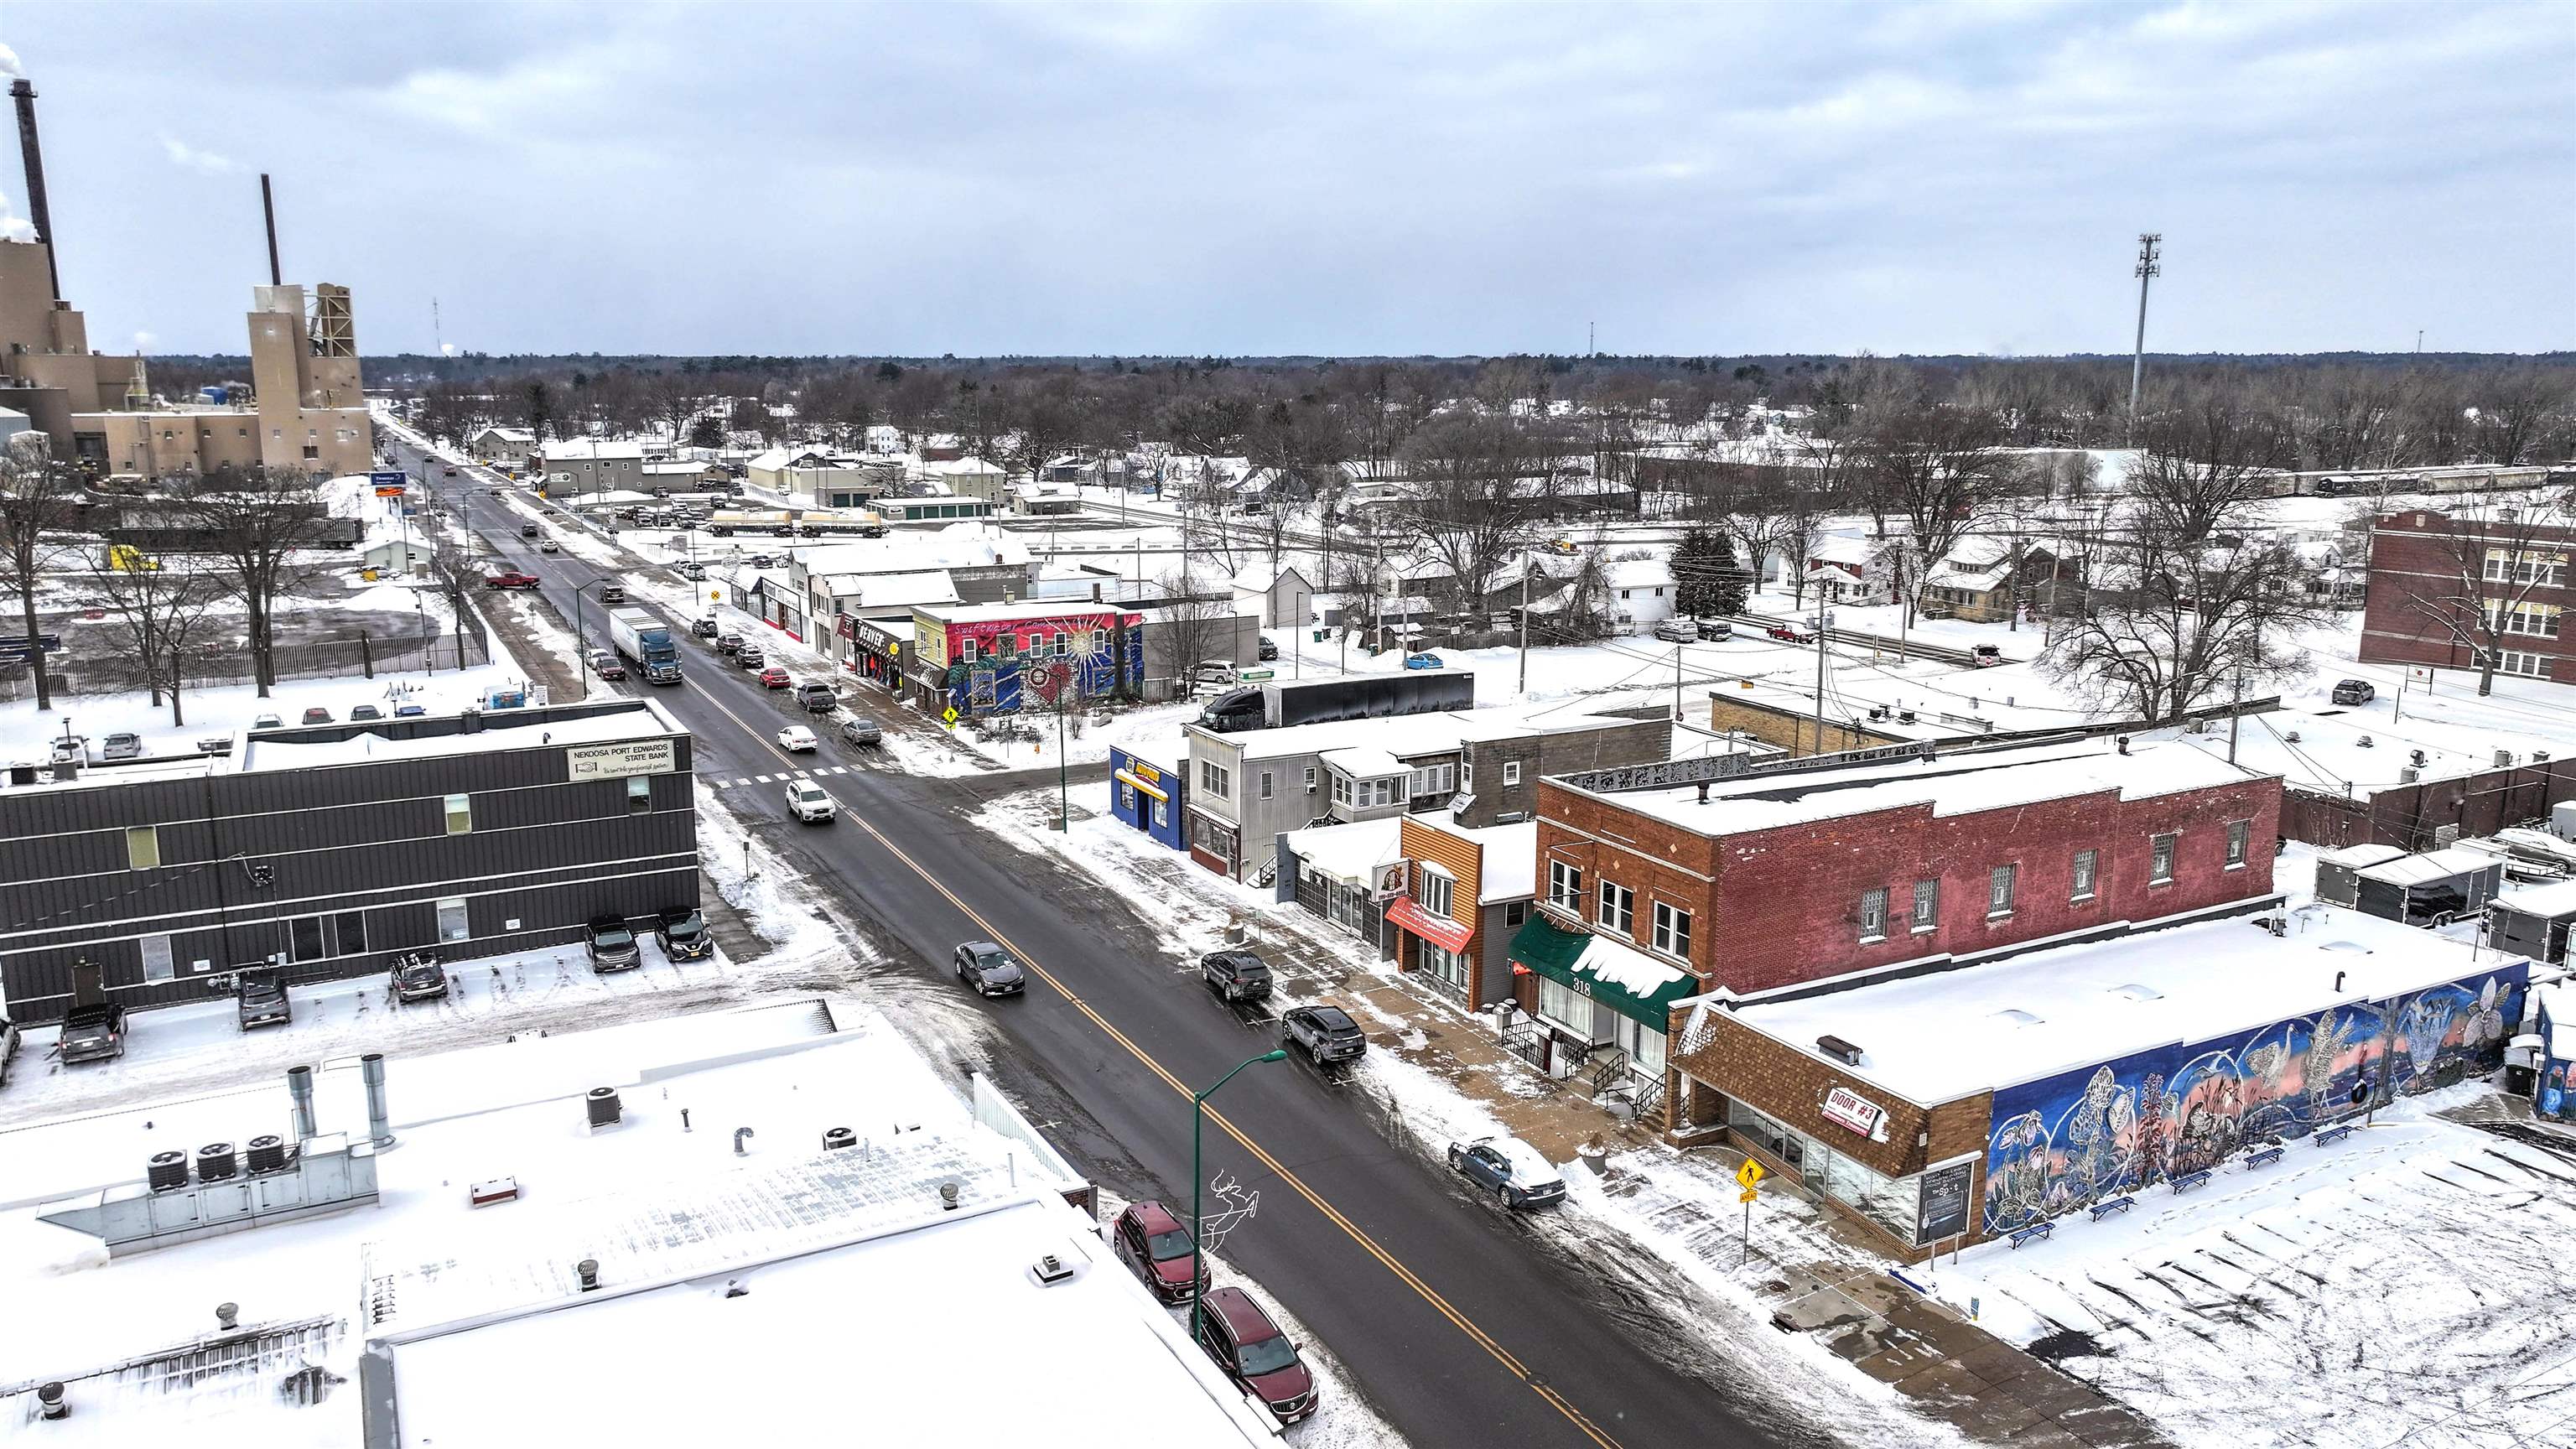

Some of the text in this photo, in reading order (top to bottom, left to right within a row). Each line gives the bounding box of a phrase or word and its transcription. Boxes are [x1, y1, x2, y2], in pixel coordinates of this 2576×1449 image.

[954, 623, 1018, 635] Swiftwater
[574, 744, 668, 759] NEKOOSA PORT EDWARDS
[625, 751, 668, 762] STATE BANK
[1573, 977, 1591, 996] 318
[1831, 1092, 1857, 1111] DOOR
[1857, 1105, 1874, 1119] #3
